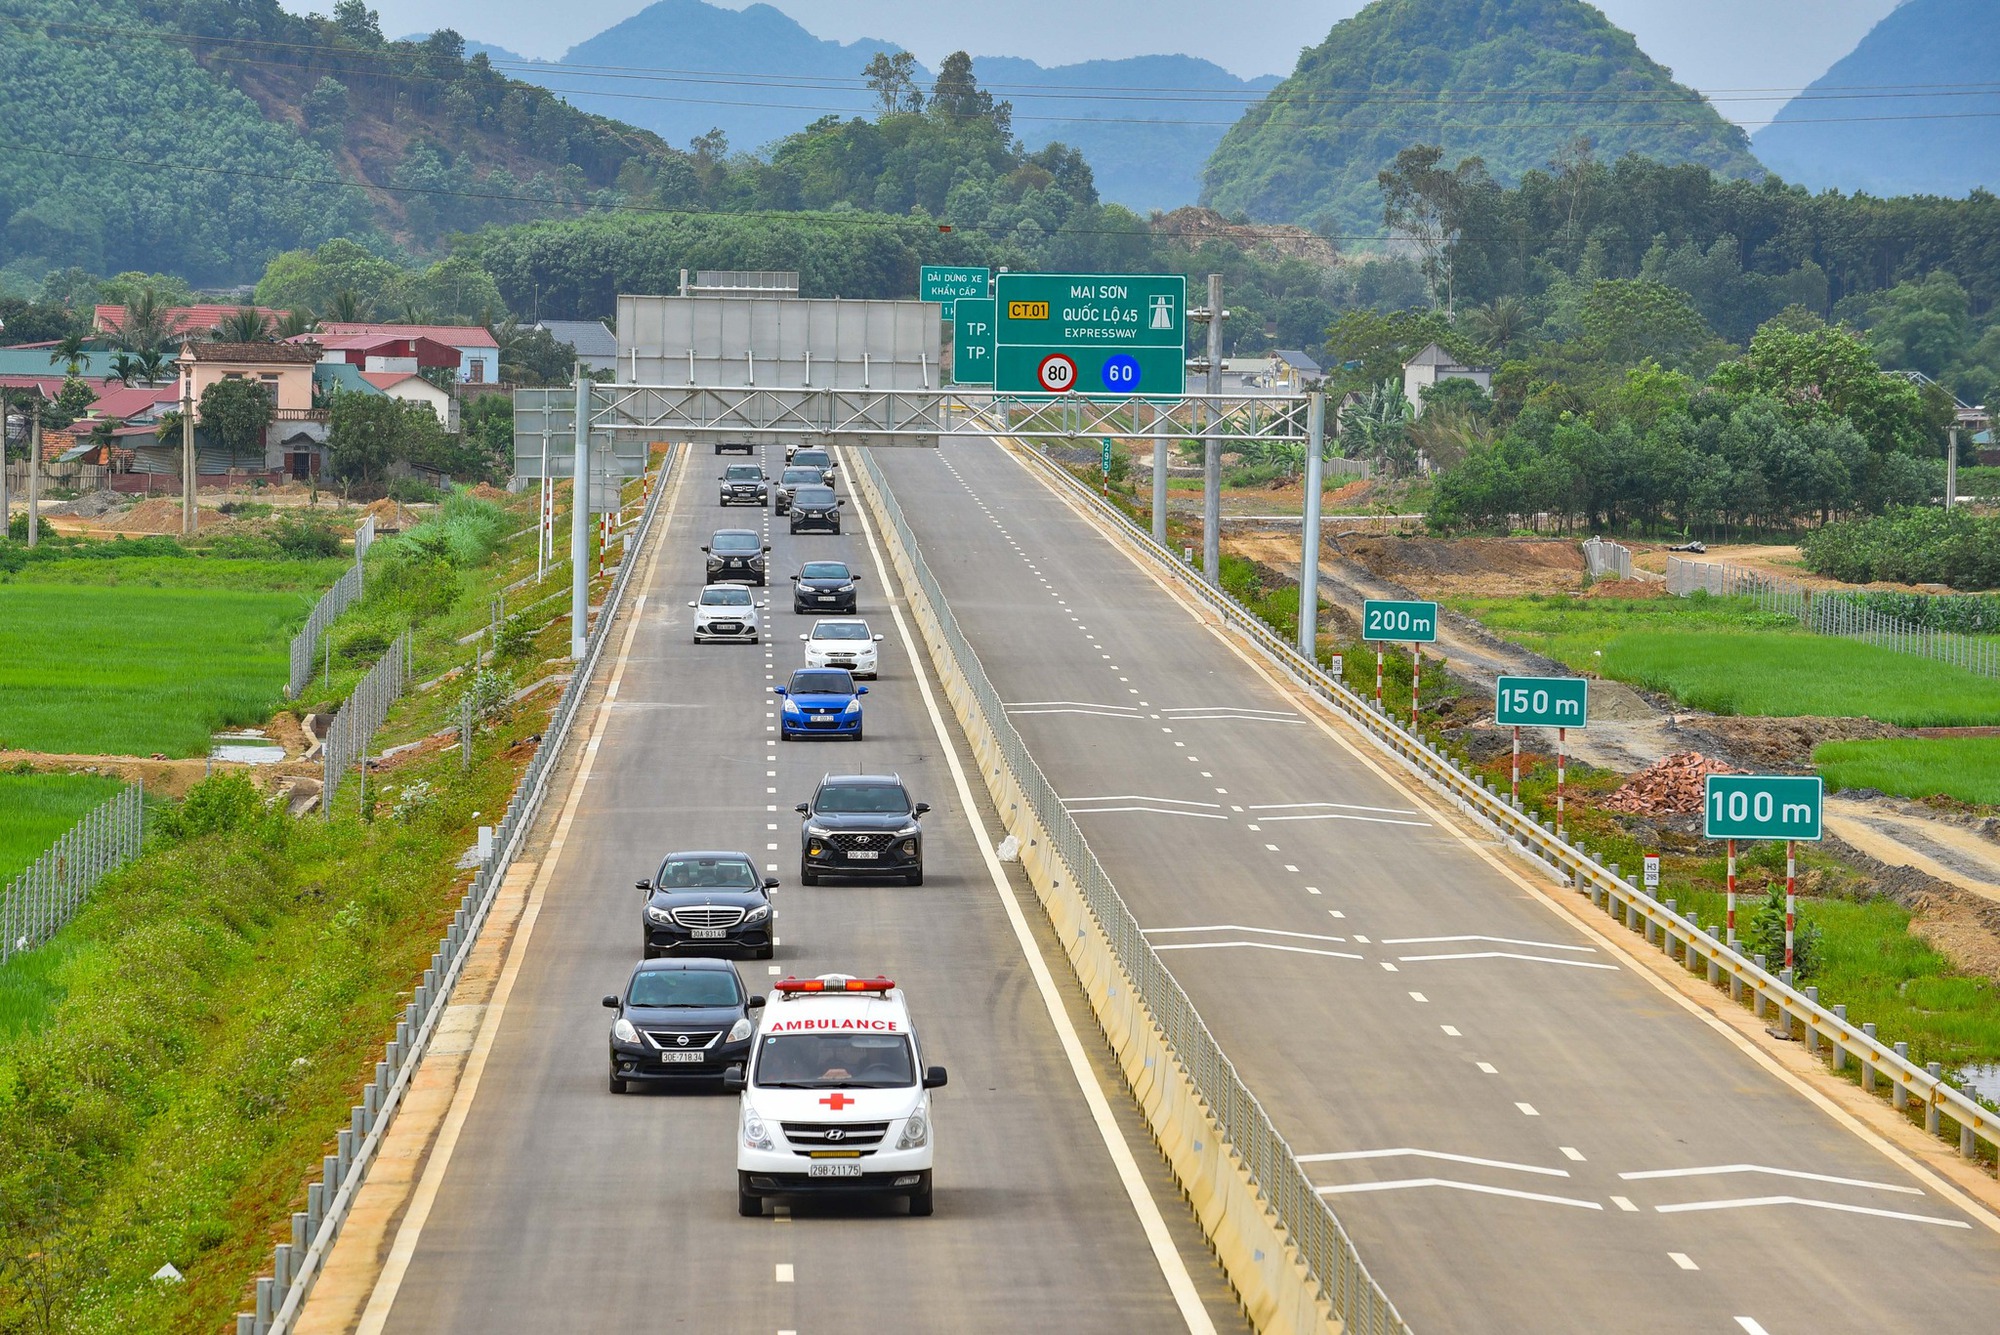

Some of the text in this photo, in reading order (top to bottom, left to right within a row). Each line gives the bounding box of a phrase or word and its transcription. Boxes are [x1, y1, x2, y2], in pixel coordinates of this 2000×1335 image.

[971, 274, 983, 283] XE
[959, 285, 977, 296] CẤP
[1070, 285, 1128, 299] MAI SƠN
[1012, 304, 1047, 317] CT.01
[1063, 303, 1138, 325] QUỐC LỘ 45
[967, 322, 991, 336] TP.
[1065, 328, 1137, 339] EXPRESSWAY
[966, 346, 990, 359] TP.
[1048, 365, 1067, 381] 80
[1109, 365, 1133, 381] 60
[1369, 610, 1430, 632] 200 m
[1501, 689, 1579, 715] 150 m
[1712, 791, 1812, 824] 100 m
[771, 1019, 897, 1032] AMBULANCE
